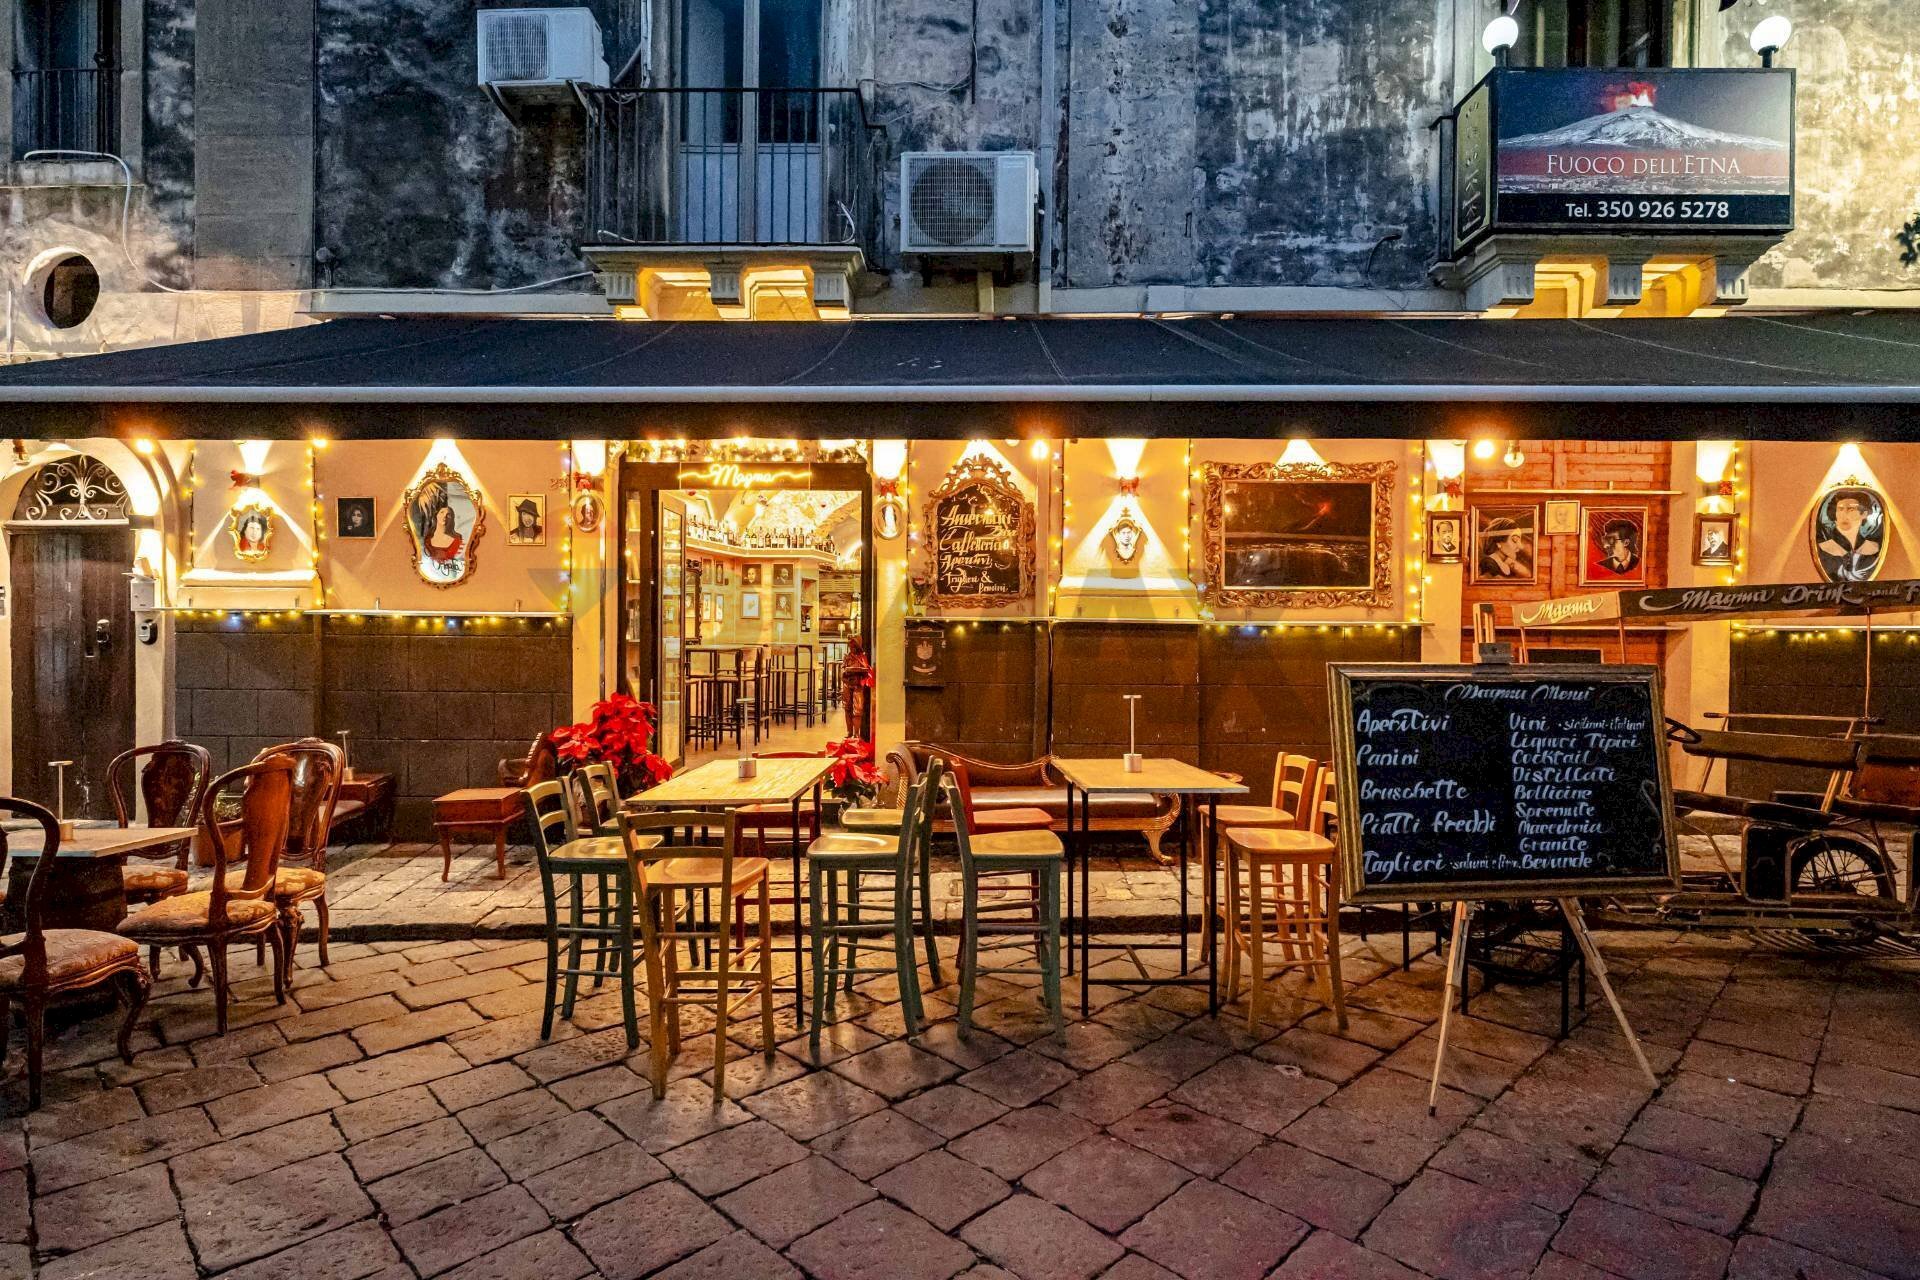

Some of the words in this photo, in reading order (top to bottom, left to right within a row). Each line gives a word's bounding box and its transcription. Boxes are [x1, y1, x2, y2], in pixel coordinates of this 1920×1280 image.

[1566, 203, 1592, 218] Tel.
[1597, 201, 1633, 218] 350
[1639, 201, 1675, 218] 926
[1681, 201, 1729, 218] 5278
[706, 463, 777, 488] Magma
[981, 570, 994, 584] &
[1640, 589, 1776, 612] Magma
[1782, 583, 1863, 605] Drink
[1521, 597, 1603, 624] Magma
[1509, 713, 1549, 731] Vini
[1357, 744, 1420, 766] Panini
[1361, 779, 1470, 800] Bruschette
[1515, 802, 1596, 821] Spremute
[1361, 812, 1420, 835] Piatti
[1519, 836, 1588, 853] Granite
[1363, 850, 1447, 881] Taglieri
[1522, 852, 1592, 869] Bevande
